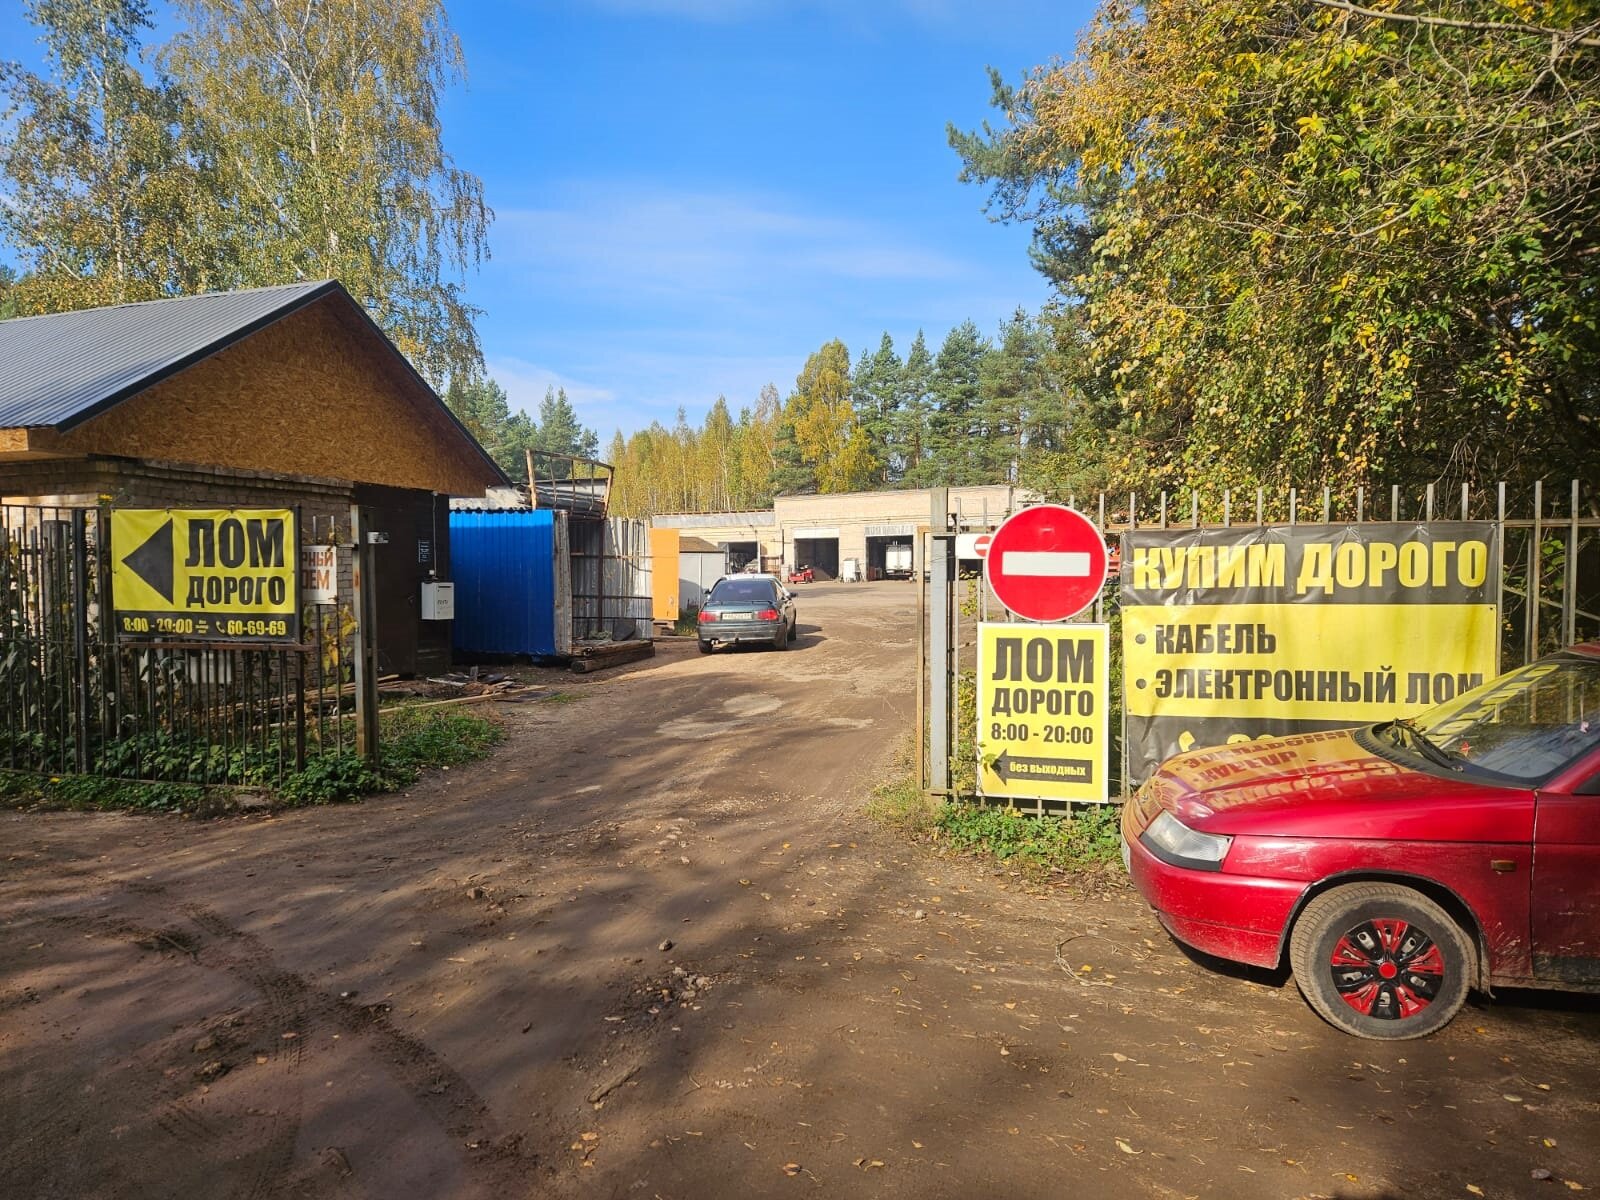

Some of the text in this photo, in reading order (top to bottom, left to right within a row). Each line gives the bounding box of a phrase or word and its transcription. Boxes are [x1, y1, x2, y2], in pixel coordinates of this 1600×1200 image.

[185, 518, 285, 568] ЛОМ
[1133, 540, 1487, 595] КУПИМ ДОРОГО
[186, 575, 286, 608] ДОРОГО
[123, 617, 149, 632] 8:00
[156, 618, 193, 634] 20:00
[227, 619, 287, 636] 60-69-69
[1155, 623, 1276, 654] КАБЕЛЬ
[992, 637, 1095, 684] ЛОМ
[1155, 665, 1396, 705] ЭЛЕКТРОННЫЙ
[991, 687, 1094, 718] ДОРОГО
[991, 722, 1029, 741] 8:00
[1043, 724, 1094, 744] 20:00
[1009, 761, 1086, 776] без выходных
